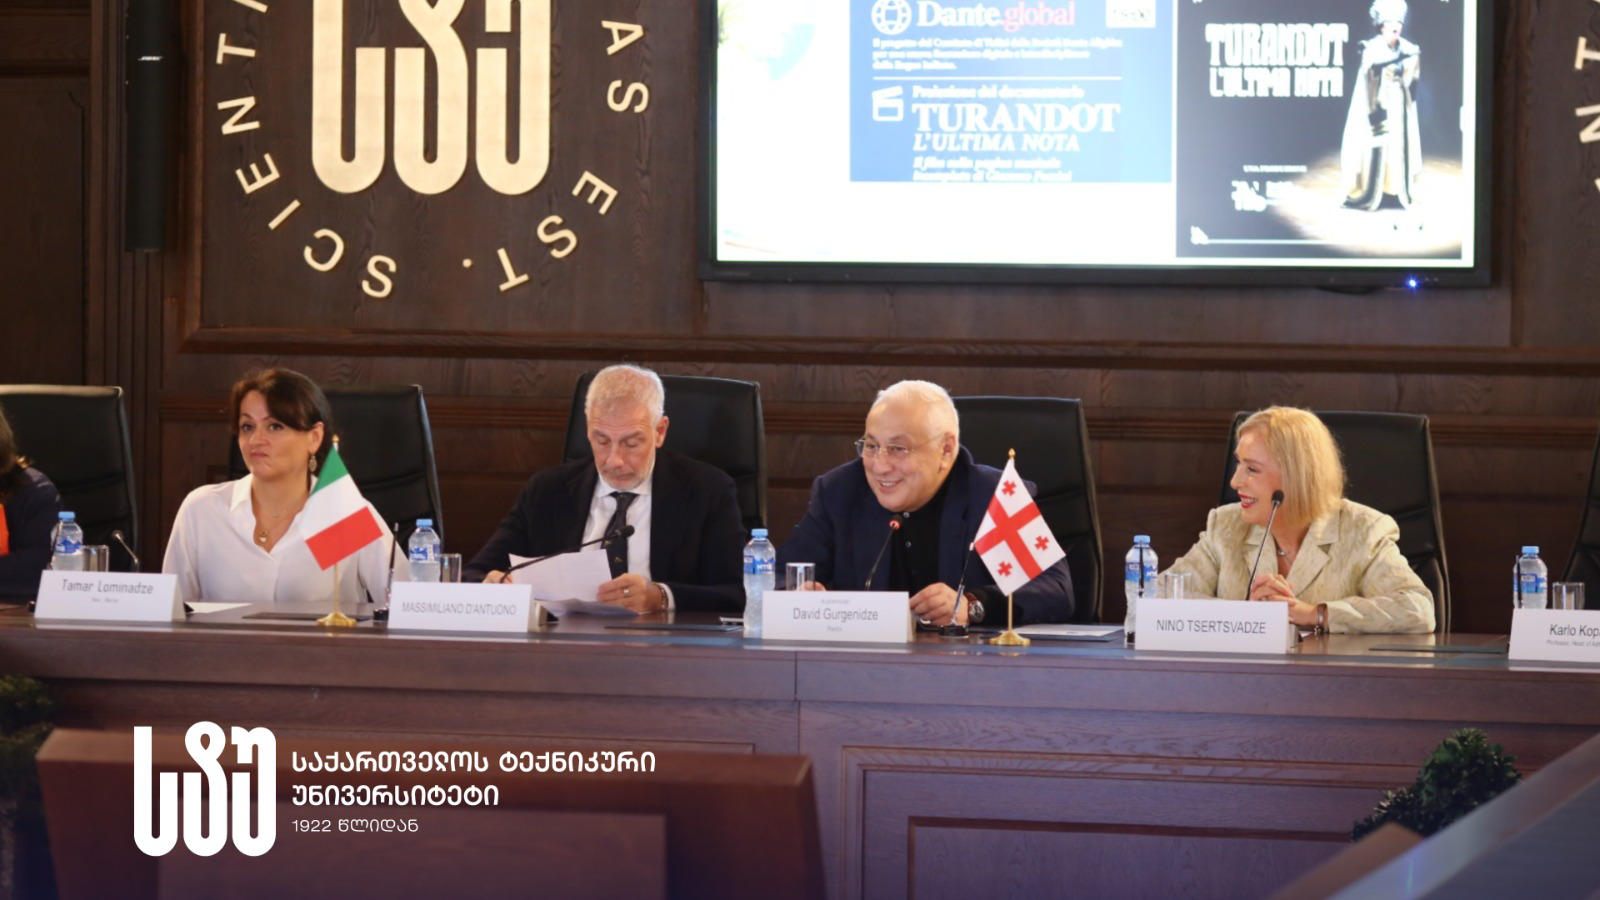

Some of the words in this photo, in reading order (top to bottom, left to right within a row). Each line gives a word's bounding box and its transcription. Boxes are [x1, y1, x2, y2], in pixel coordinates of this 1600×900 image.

[1205, 23, 1349, 67] TURANDOT
[912, 103, 1121, 132] TURANDOT
[913, 133, 1015, 151] L'ULTIMA
[1022, 134, 1080, 151] NOTA
[62, 579, 94, 592] Tamar
[97, 580, 154, 594] Lominadze
[402, 601, 463, 614] MASSIMILIANO
[793, 607, 820, 620] David
[823, 607, 879, 623] Gurgenidze
[1156, 619, 1185, 632] NINO
[1187, 619, 1266, 634] TSERTSVADZE
[1549, 624, 1577, 636] Karlo
[1579, 625, 1600, 639] Kop
